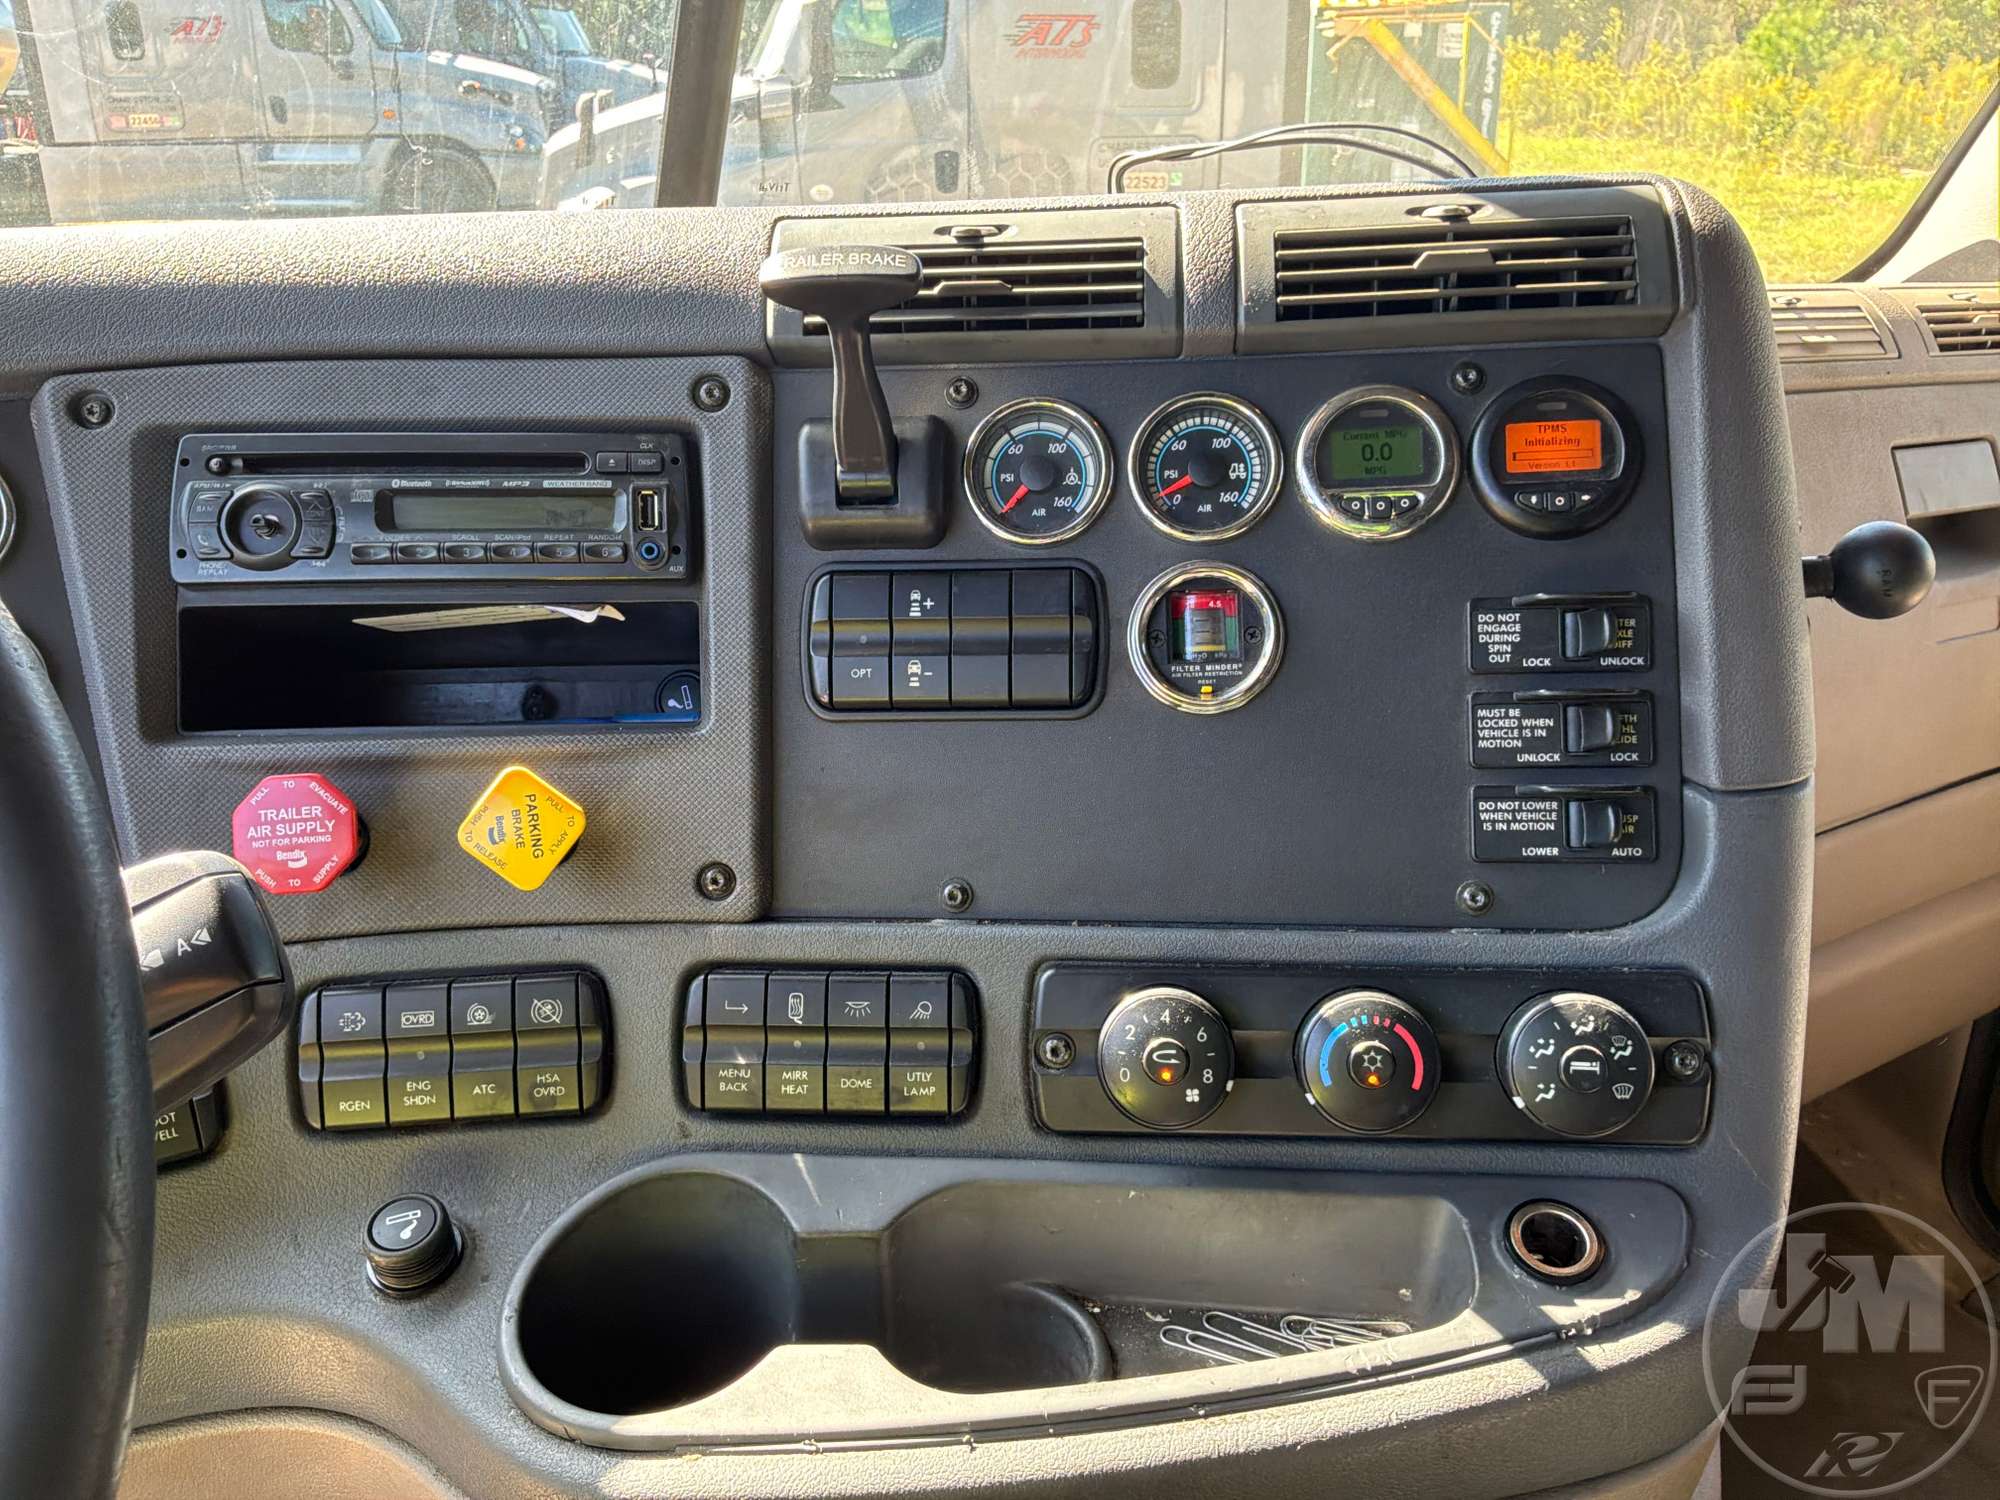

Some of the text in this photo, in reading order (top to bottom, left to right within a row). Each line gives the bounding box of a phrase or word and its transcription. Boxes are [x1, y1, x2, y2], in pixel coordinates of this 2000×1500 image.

[779, 252, 907, 268] RAILER BRAKE
[1537, 423, 1568, 433] TPMS
[1170, 439, 1187, 450] 60
[1211, 437, 1231, 449] 100
[1524, 436, 1581, 447] Initializing
[1007, 444, 1023, 455] 60
[1047, 443, 1067, 454] 100
[1361, 442, 1393, 462] 0.0
[637, 458, 657, 466] DISP
[1000, 473, 1014, 483] PSI
[1163, 469, 1179, 479] PSI
[1053, 496, 1073, 508] 160
[1172, 494, 1181, 505] 0
[1218, 491, 1239, 503] 160
[1031, 508, 1047, 517] AIR
[1197, 504, 1212, 513] AIR
[668, 565, 684, 573] AUX
[1478, 613, 1521, 623] DO NOT
[1477, 623, 1521, 633] ENGAGE
[1616, 629, 1634, 638] XLE
[1478, 634, 1521, 643] DURING
[1488, 644, 1512, 653] SPIN
[1488, 654, 1511, 664] OUT
[1522, 657, 1551, 667] LOCK
[1600, 656, 1645, 666] UNLOCK
[850, 667, 873, 679] OPT
[1477, 708, 1521, 718] MUST BE
[1477, 717, 1554, 728] LOCKED WHEN
[1477, 728, 1547, 739] VEHICLE IS IN
[1477, 738, 1522, 748] MOTION
[1516, 752, 1561, 763] UNLOCK
[1610, 751, 1639, 762] LOCK
[250, 780, 349, 816] PULL TO EVACUATE
[1478, 801, 1559, 811] DO NOT LOWER
[257, 805, 323, 822] TRAILER
[546, 796, 564, 814] PULL
[567, 815, 576, 828] TO
[1479, 811, 1558, 821] WHEN VEHICLE
[247, 819, 336, 840] AIR SUPPLY
[511, 808, 526, 850] BRAKE
[524, 793, 545, 860] PARKING
[1482, 821, 1556, 831] IS IN MOTION
[252, 834, 333, 849] NOT FOR PARKING
[464, 805, 509, 871] PUSH TO RELEASE
[276, 849, 306, 861] Bendix
[1522, 847, 1559, 857] LOWER
[1611, 847, 1643, 857] AUTO
[254, 854, 340, 889] PUSH TO SUPPLY
[177, 938, 192, 957] A
[402, 1013, 434, 1026] OVRD
[1159, 1008, 1171, 1025] 4
[1124, 1025, 1136, 1041] 2
[1196, 1027, 1208, 1043] 6
[536, 1073, 561, 1084] HSA
[718, 1069, 751, 1080] MENU
[781, 1070, 809, 1081] MIRR
[906, 1071, 933, 1082] UTLY
[1119, 1067, 1131, 1083] 0
[1202, 1068, 1214, 1084] 8
[406, 1080, 432, 1092] ENG
[719, 1081, 749, 1093] BACK
[840, 1078, 873, 1089] DOME
[472, 1083, 496, 1096] ATC
[533, 1085, 566, 1098] OVRD
[780, 1084, 809, 1095] HEAT
[903, 1086, 937, 1097] LAMP
[339, 1100, 371, 1112] RGEN
[403, 1094, 437, 1107] SHDN
